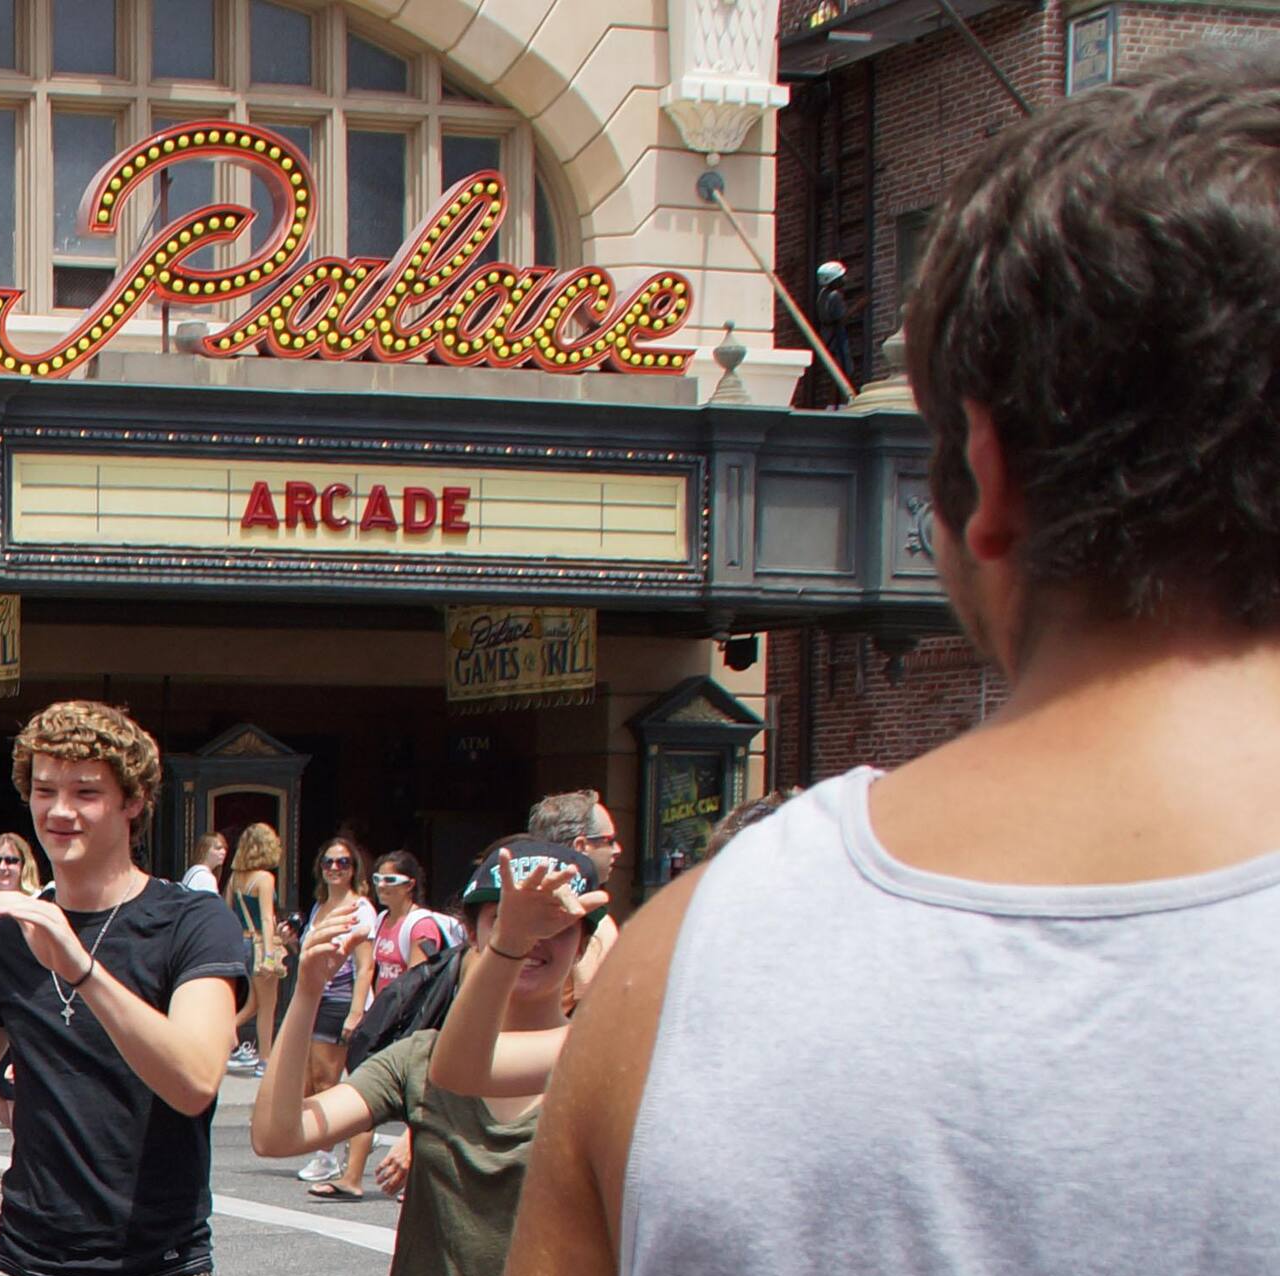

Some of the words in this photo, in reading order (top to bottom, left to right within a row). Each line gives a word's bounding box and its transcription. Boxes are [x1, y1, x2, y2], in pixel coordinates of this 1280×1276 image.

[241, 480, 471, 536] ARCADE
[458, 612, 533, 660] Palace
[455, 647, 520, 687] GAMES
[457, 736, 490, 751] ATM
